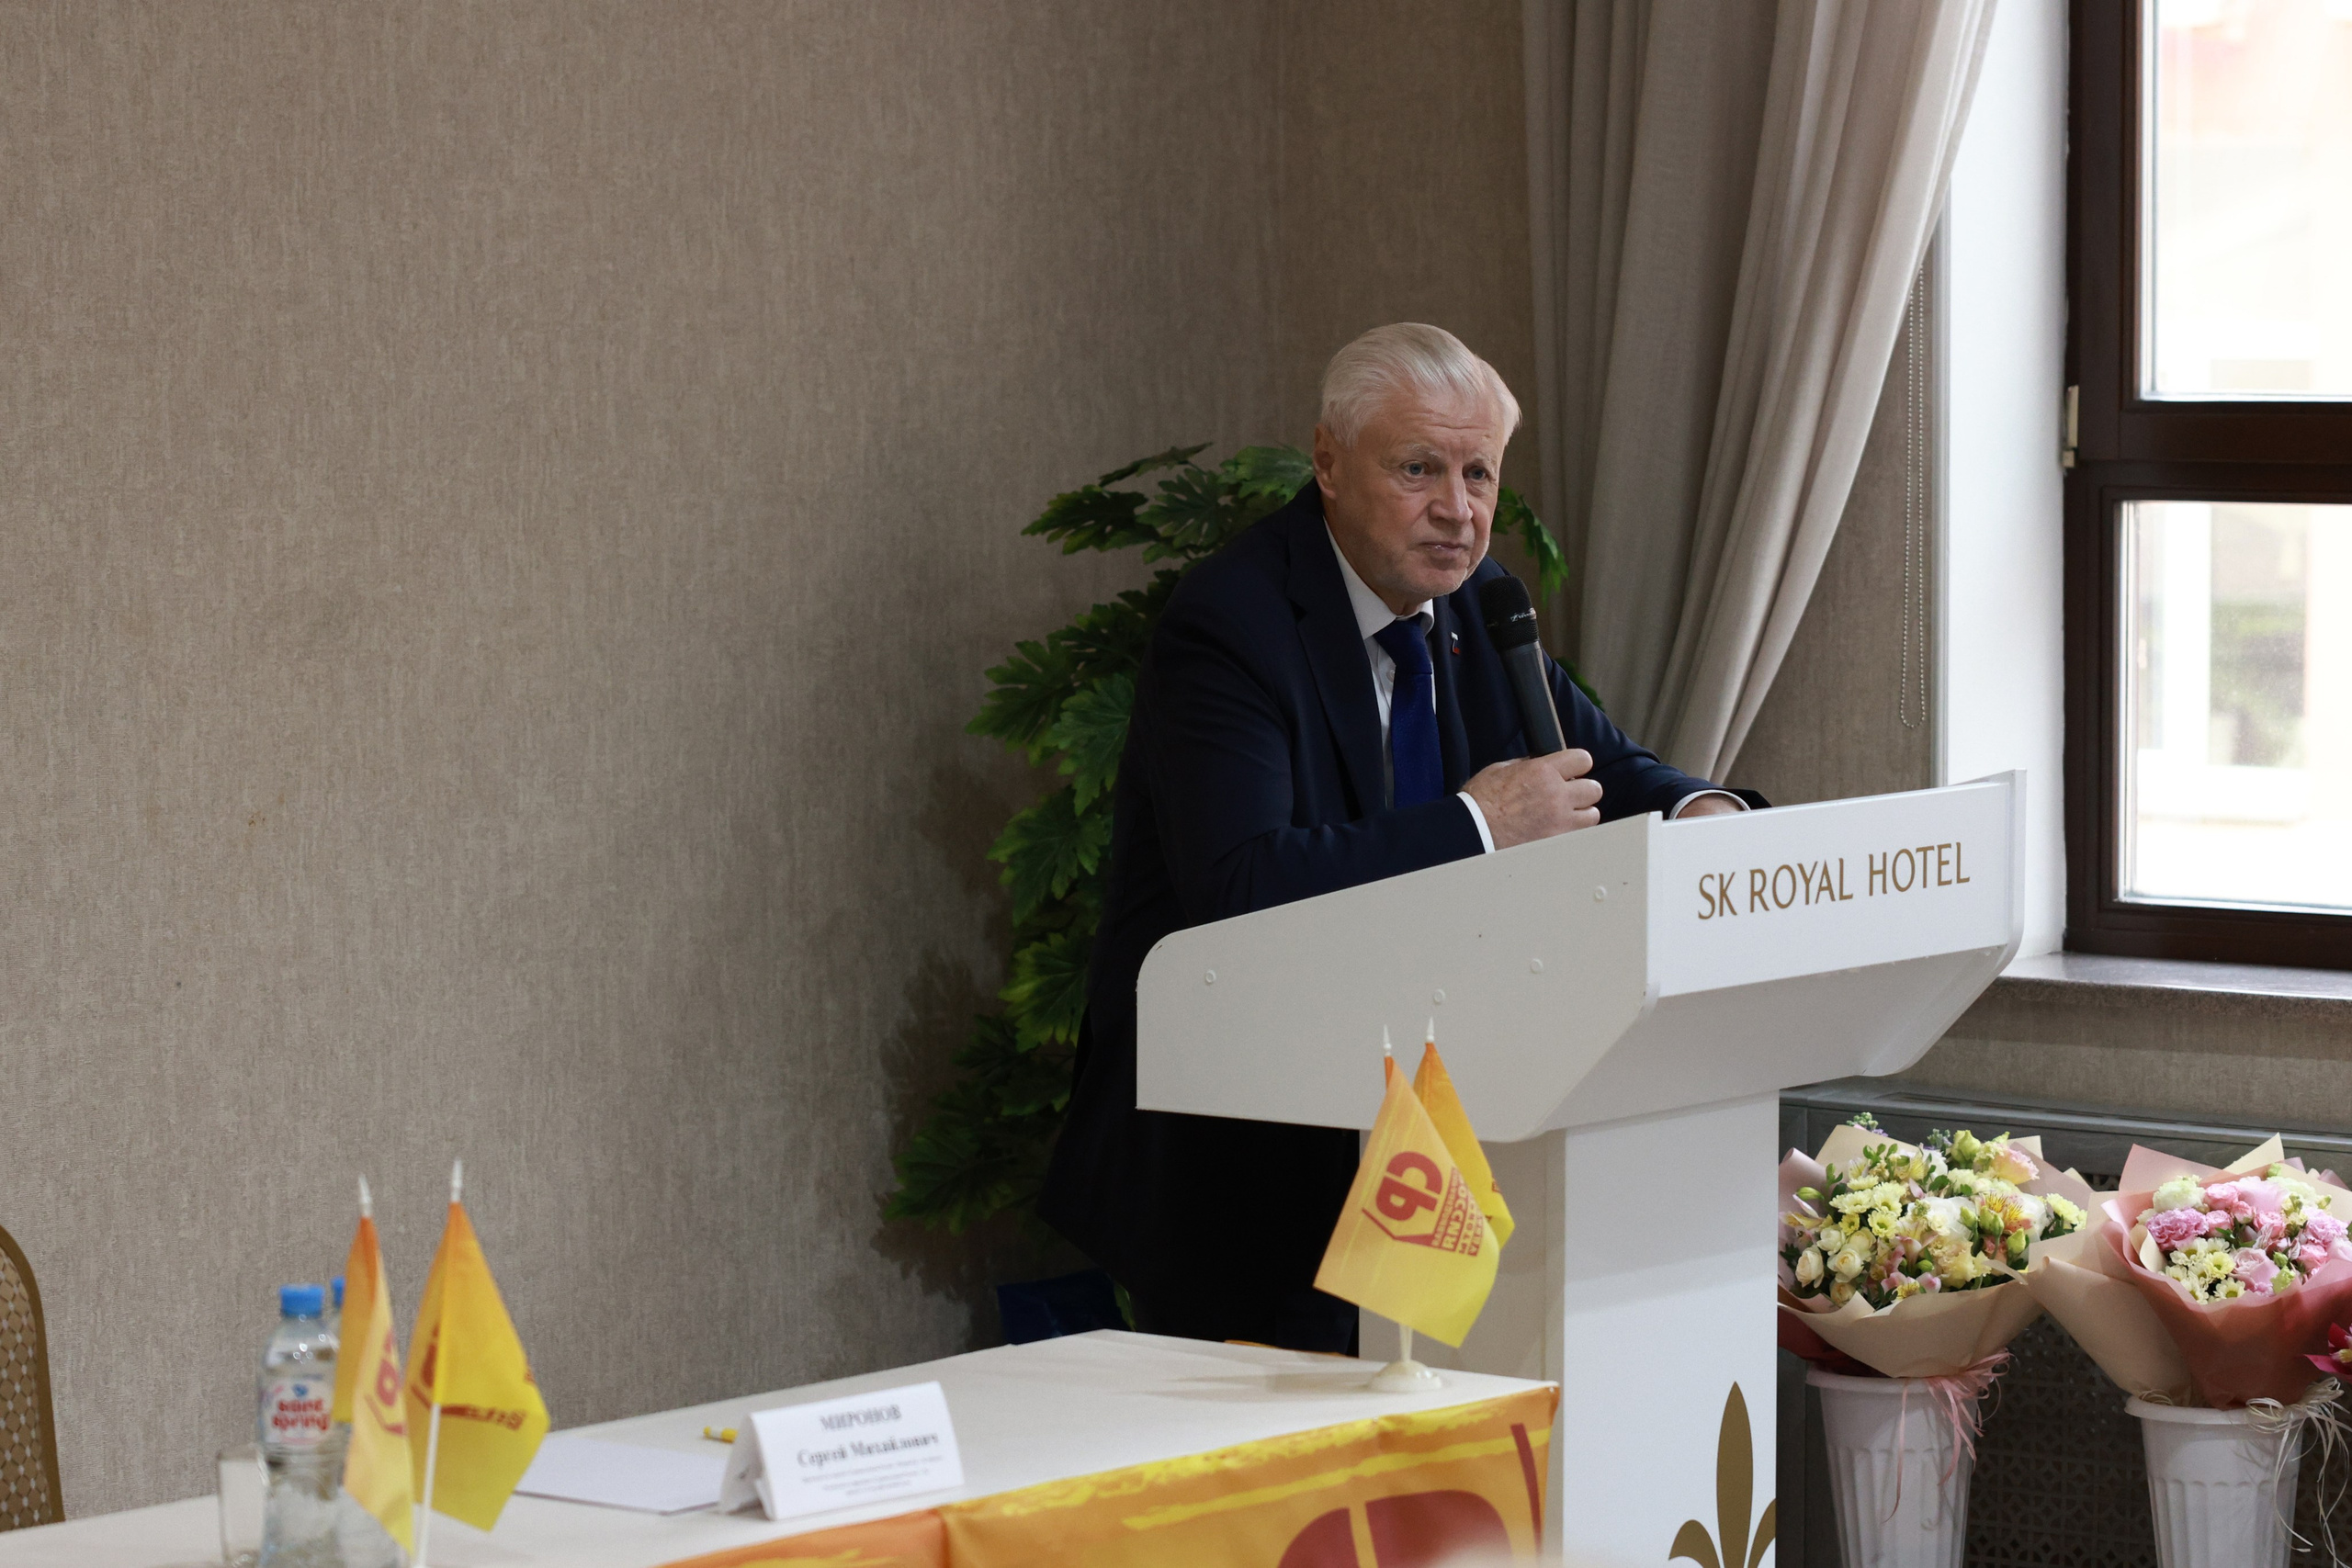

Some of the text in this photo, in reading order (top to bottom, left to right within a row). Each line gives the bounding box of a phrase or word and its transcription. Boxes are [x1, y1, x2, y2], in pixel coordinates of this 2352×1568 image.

[1698, 841, 1971, 919] SK ROYAL HOTEL
